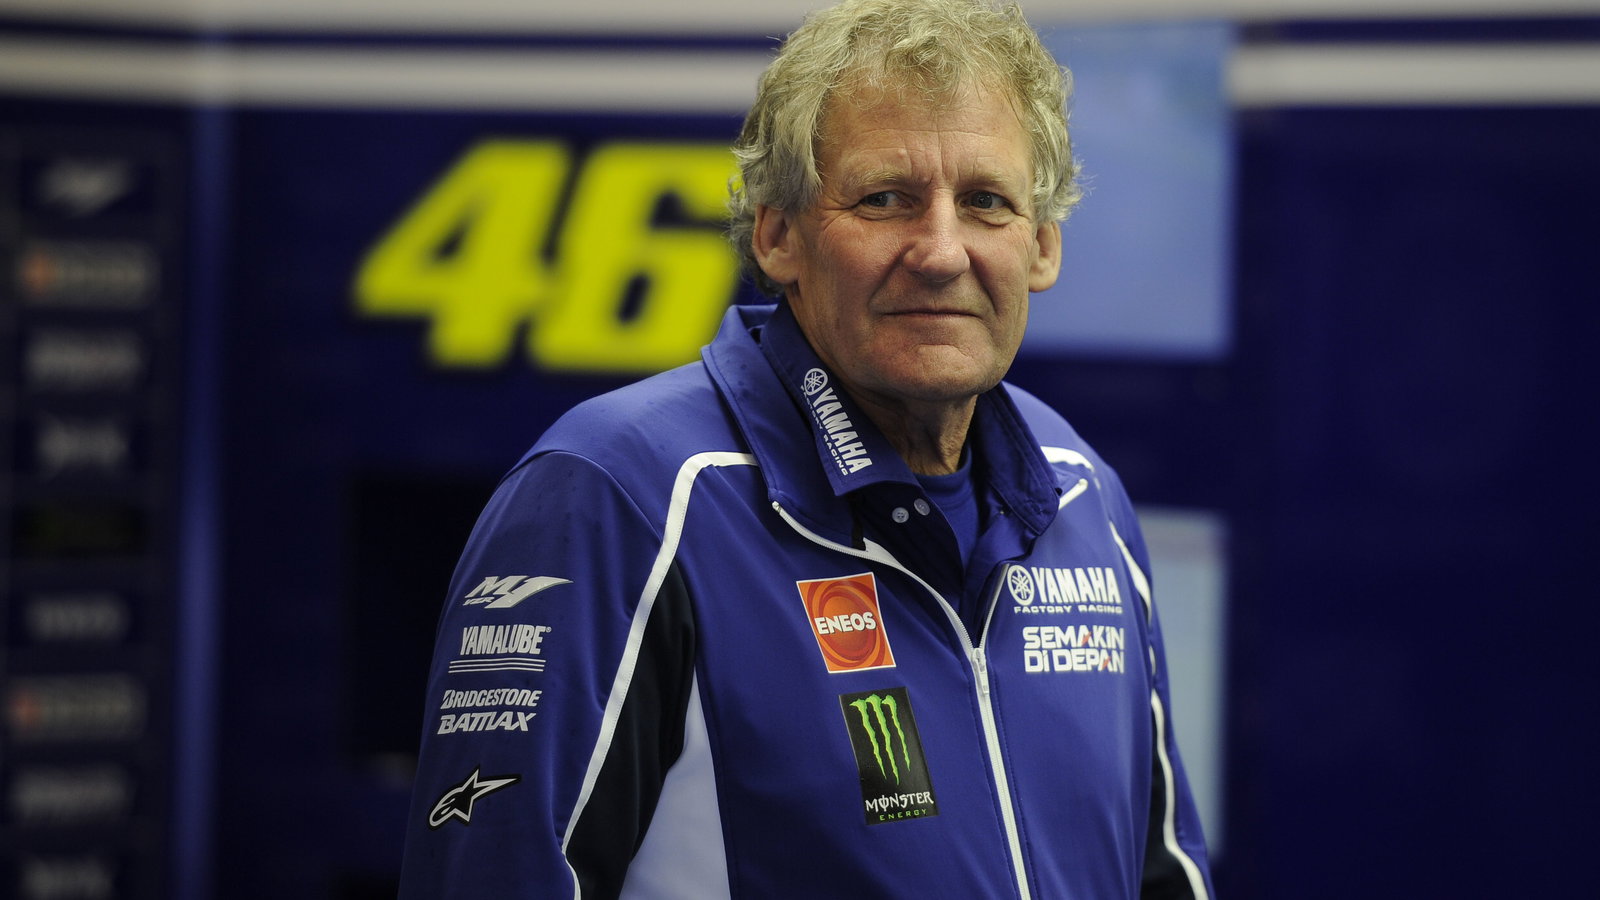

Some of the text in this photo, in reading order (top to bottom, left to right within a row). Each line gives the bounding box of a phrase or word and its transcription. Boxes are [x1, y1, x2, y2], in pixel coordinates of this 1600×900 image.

[355, 143, 741, 371] 46
[813, 387, 873, 473] YAMAHA
[824, 434, 849, 476] RACING
[1031, 567, 1122, 604] YAMAHA
[1014, 605, 1123, 614] FACTORY RACING
[814, 612, 876, 635] ENEOS
[460, 624, 547, 655] YAMALUBE
[1023, 625, 1124, 650] SEMAKIN
[1052, 648, 1124, 674] DEPAN
[440, 688, 542, 709] BRIDGESTONE
[879, 809, 928, 821] ENERGY
